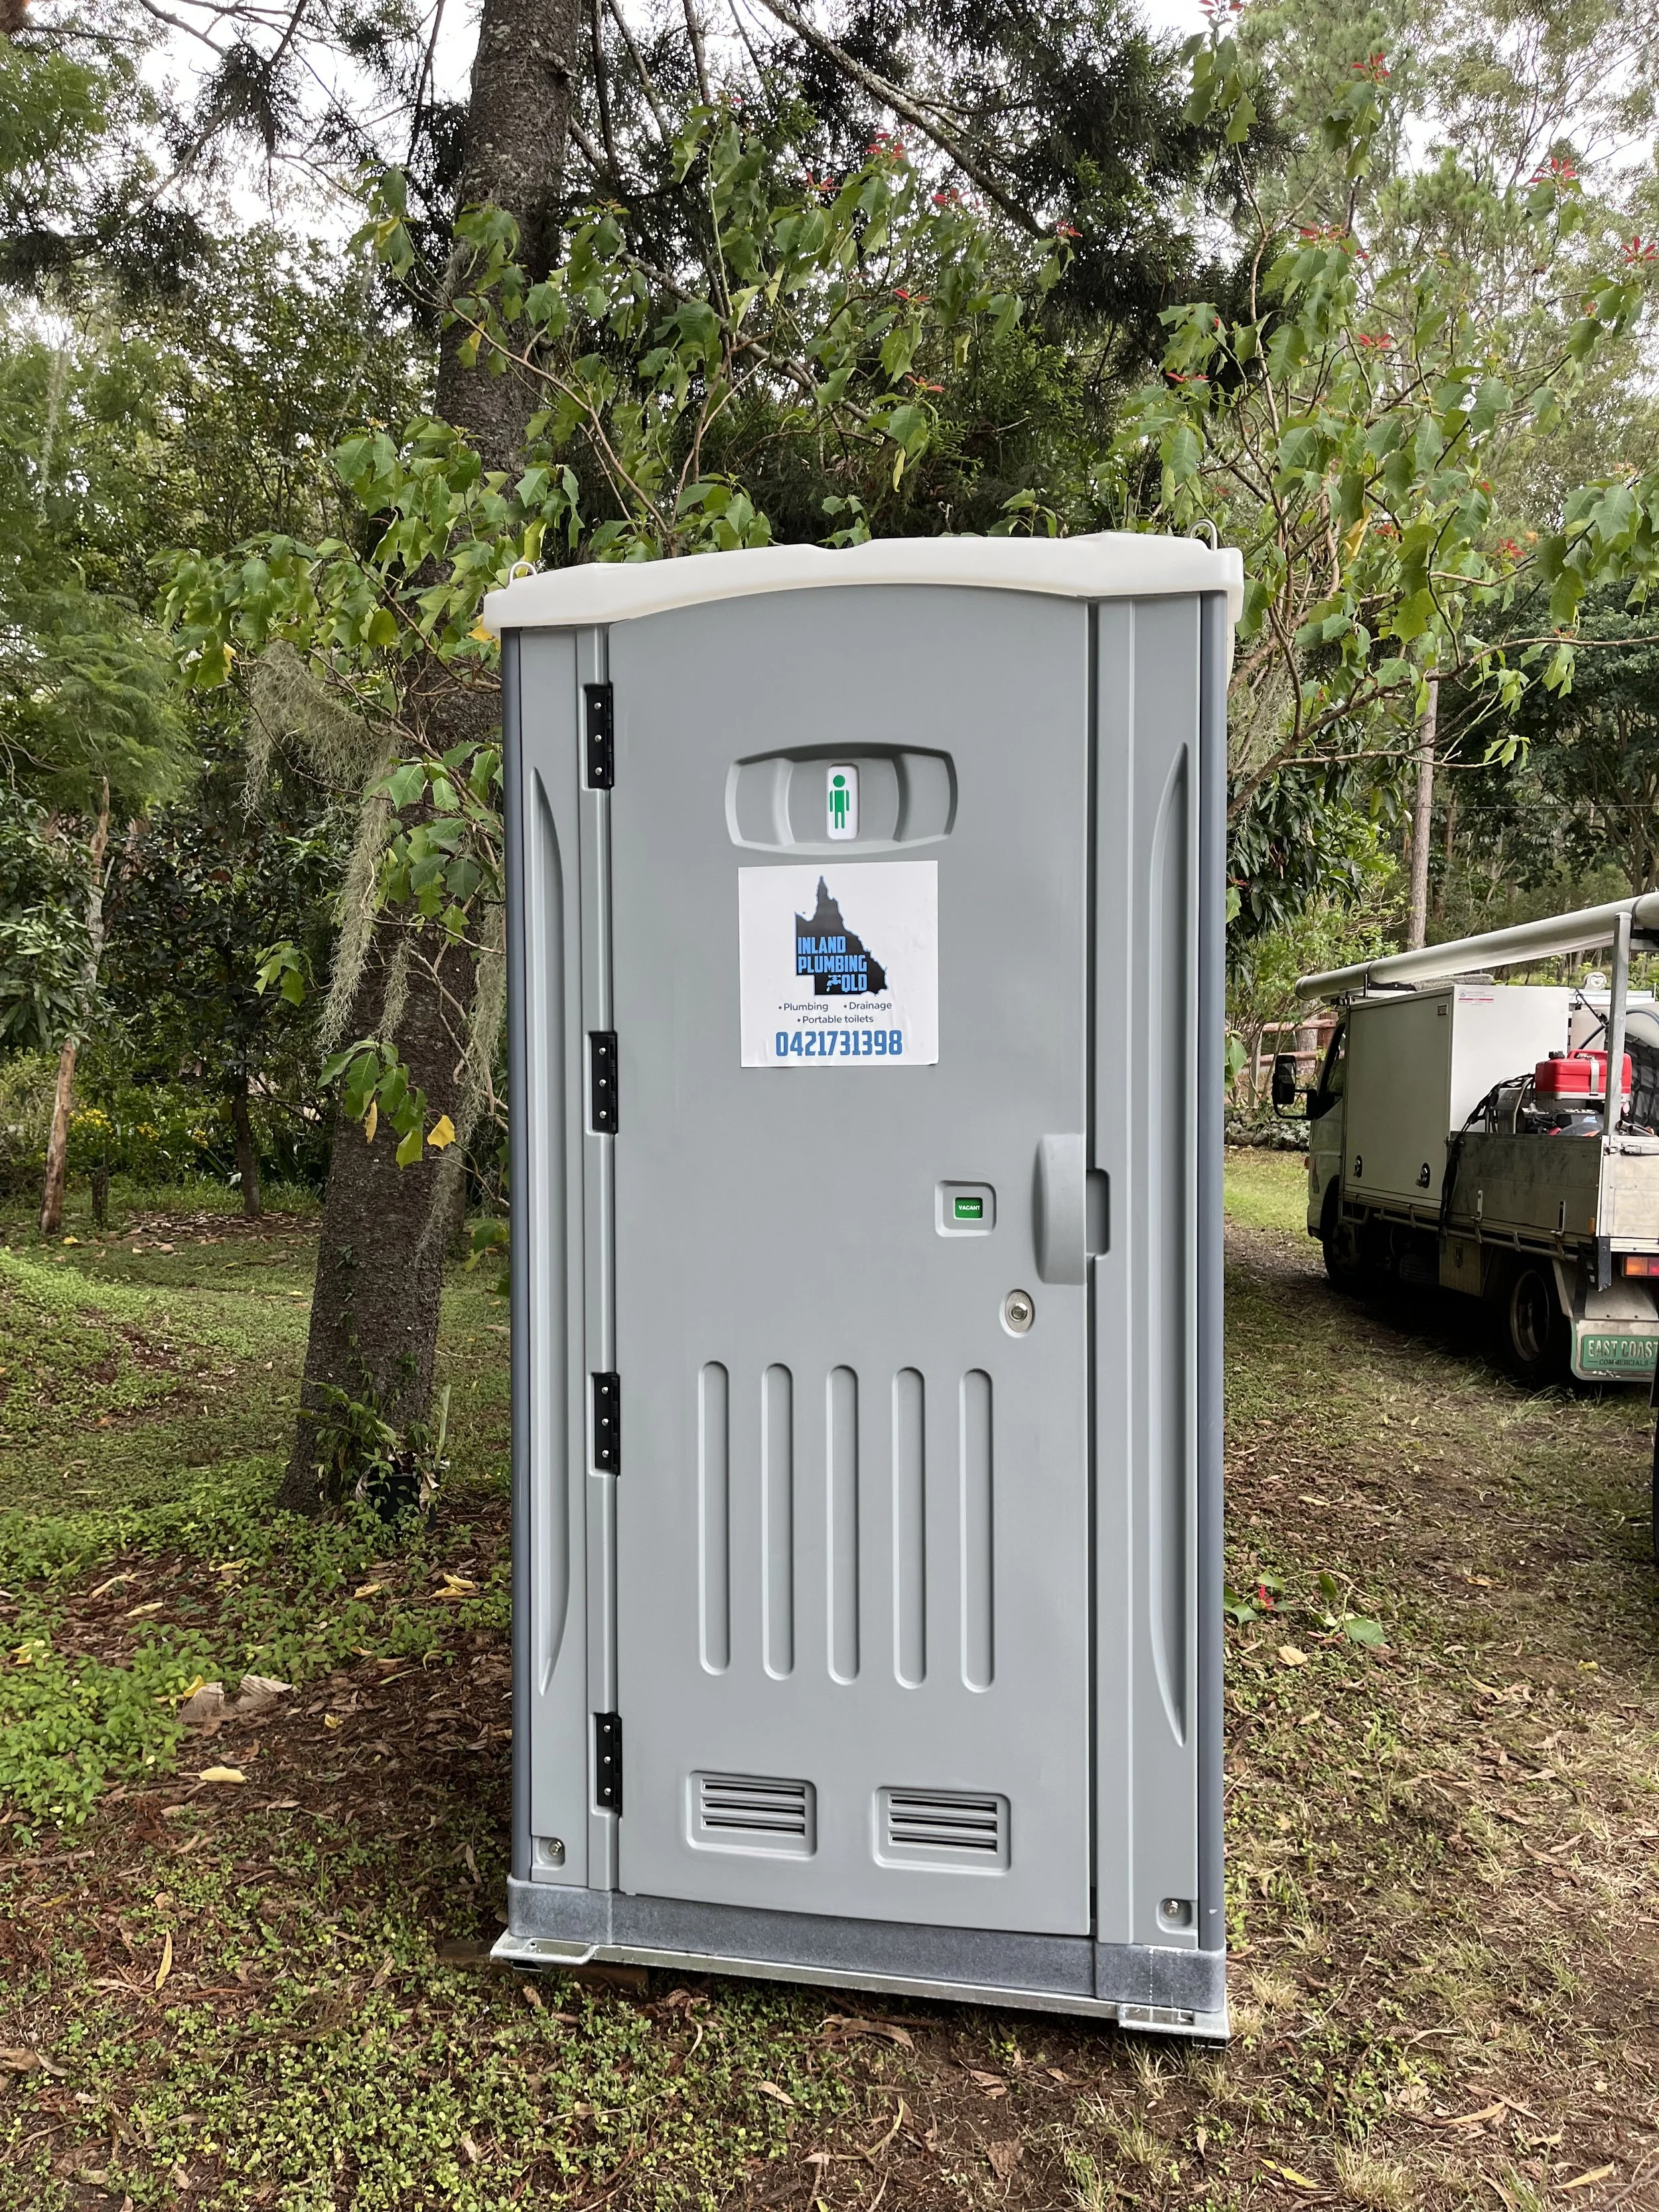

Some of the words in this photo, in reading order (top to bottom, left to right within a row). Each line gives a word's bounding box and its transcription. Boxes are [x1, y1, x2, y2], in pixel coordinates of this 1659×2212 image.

[798, 936, 846, 954] INLAND
[798, 954, 867, 974] PLUMBING
[841, 974, 867, 993] QLD
[784, 1002, 829, 1012] Plumbing
[849, 1001, 893, 1011] Drainage
[845, 1015, 874, 1023] toilets
[776, 1029, 902, 1057] 0421731398
[1588, 1339, 1618, 1357] EAST
